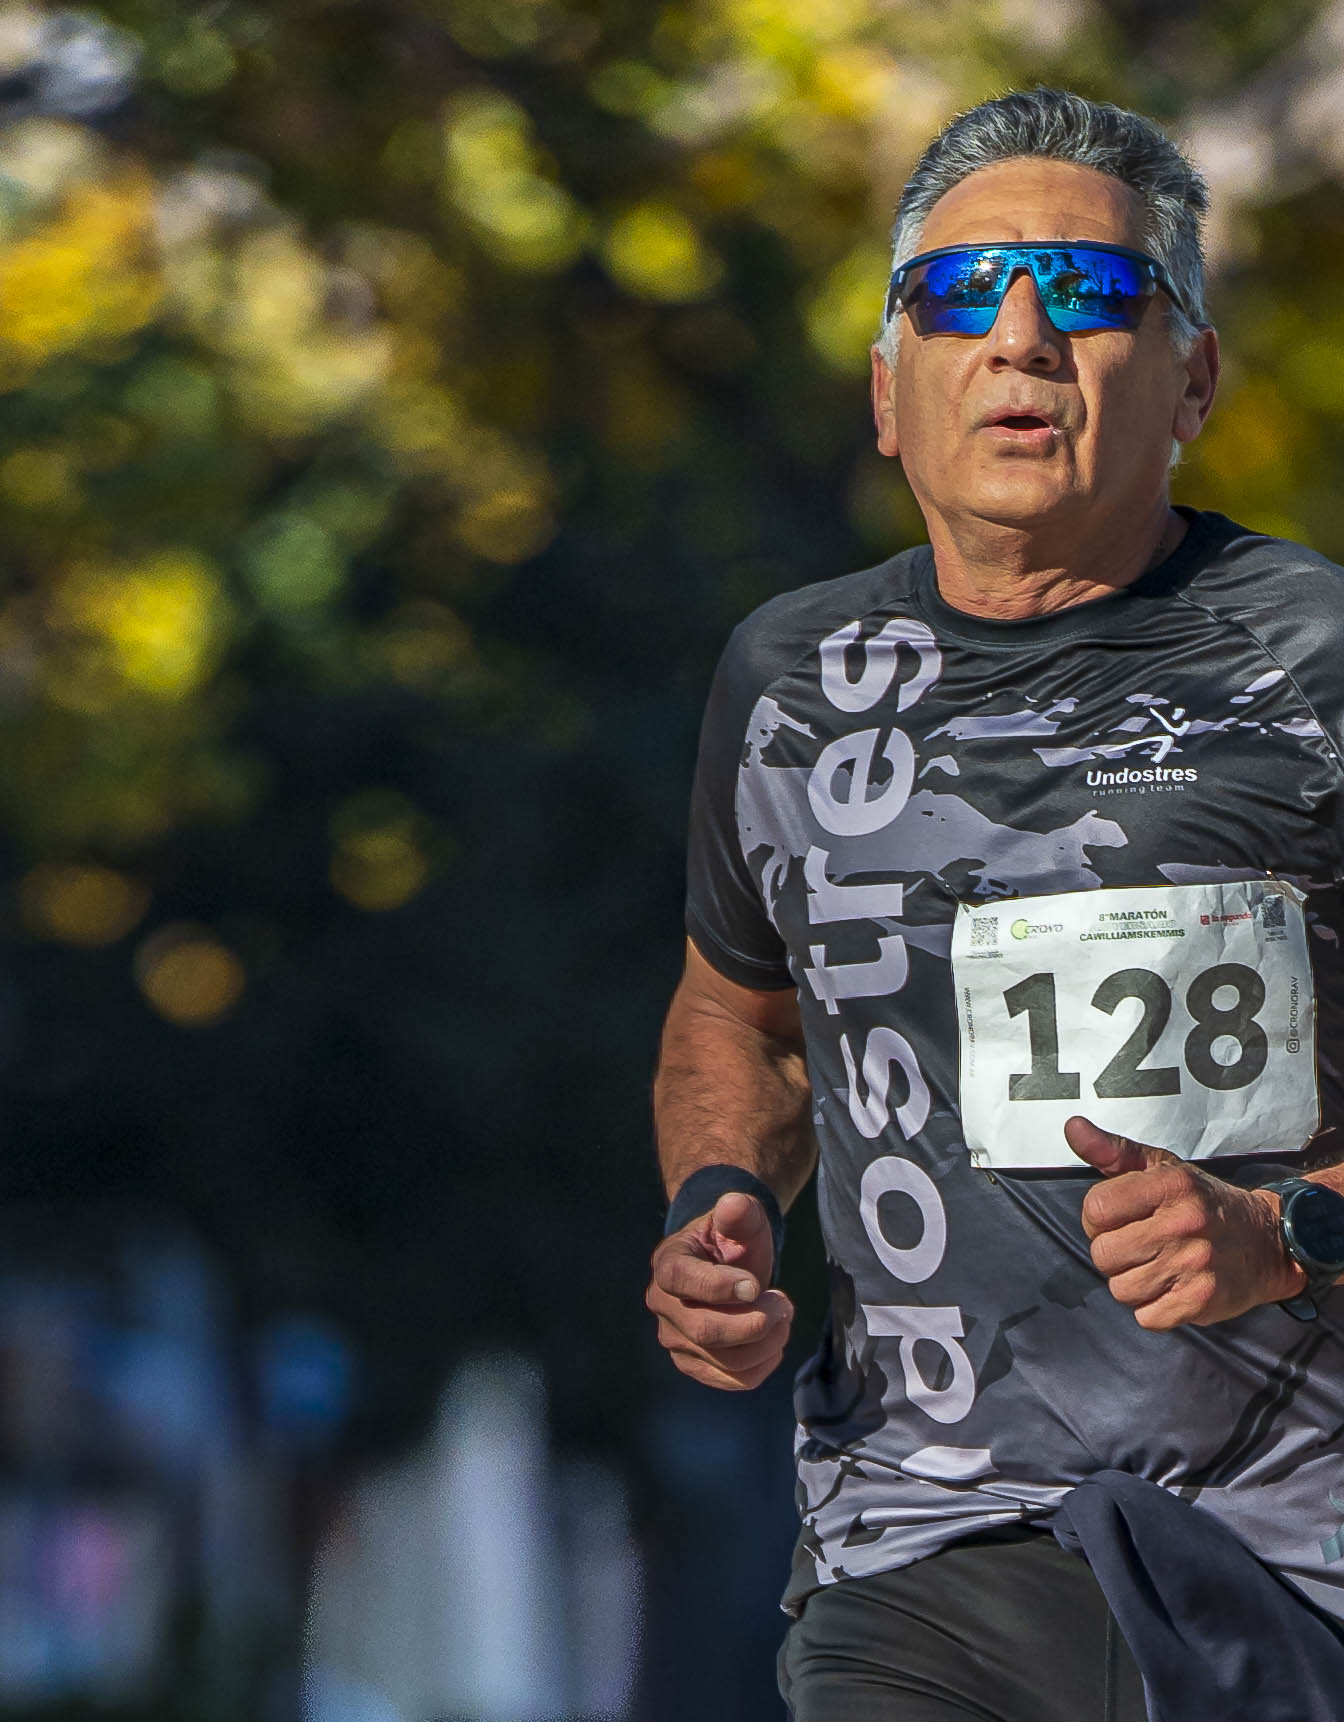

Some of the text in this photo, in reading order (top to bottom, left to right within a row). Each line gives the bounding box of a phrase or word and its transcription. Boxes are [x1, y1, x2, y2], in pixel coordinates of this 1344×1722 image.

[1086, 766, 1198, 786] Undostres
[1092, 784, 1185, 797] running team
[1002, 962, 1269, 1102] 128
